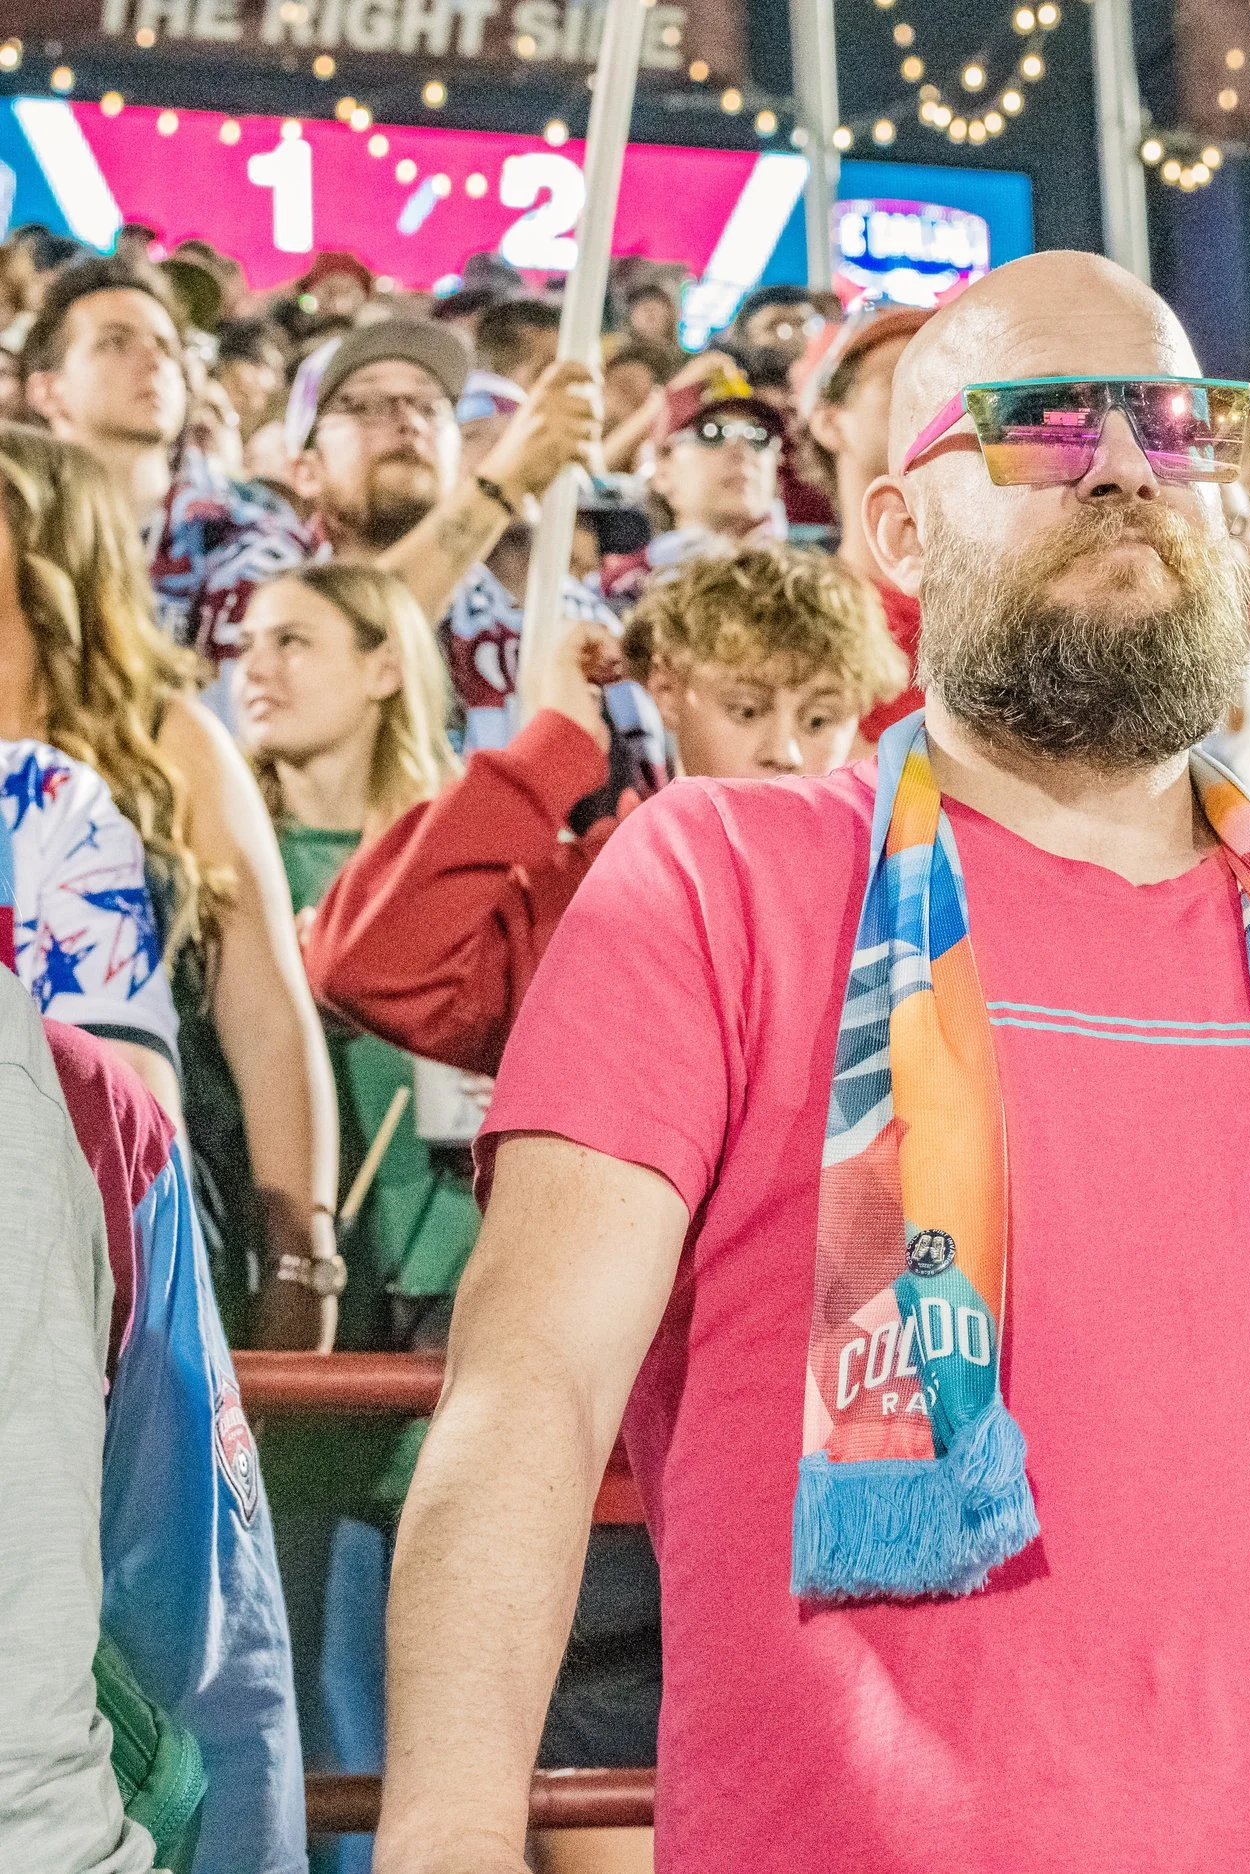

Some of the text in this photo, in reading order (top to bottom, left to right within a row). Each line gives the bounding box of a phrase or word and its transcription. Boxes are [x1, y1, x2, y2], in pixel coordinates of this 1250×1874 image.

[261, 0, 500, 57] RIGHT
[511, 4, 686, 69] SIE
[247, 139, 586, 270] 1 2
